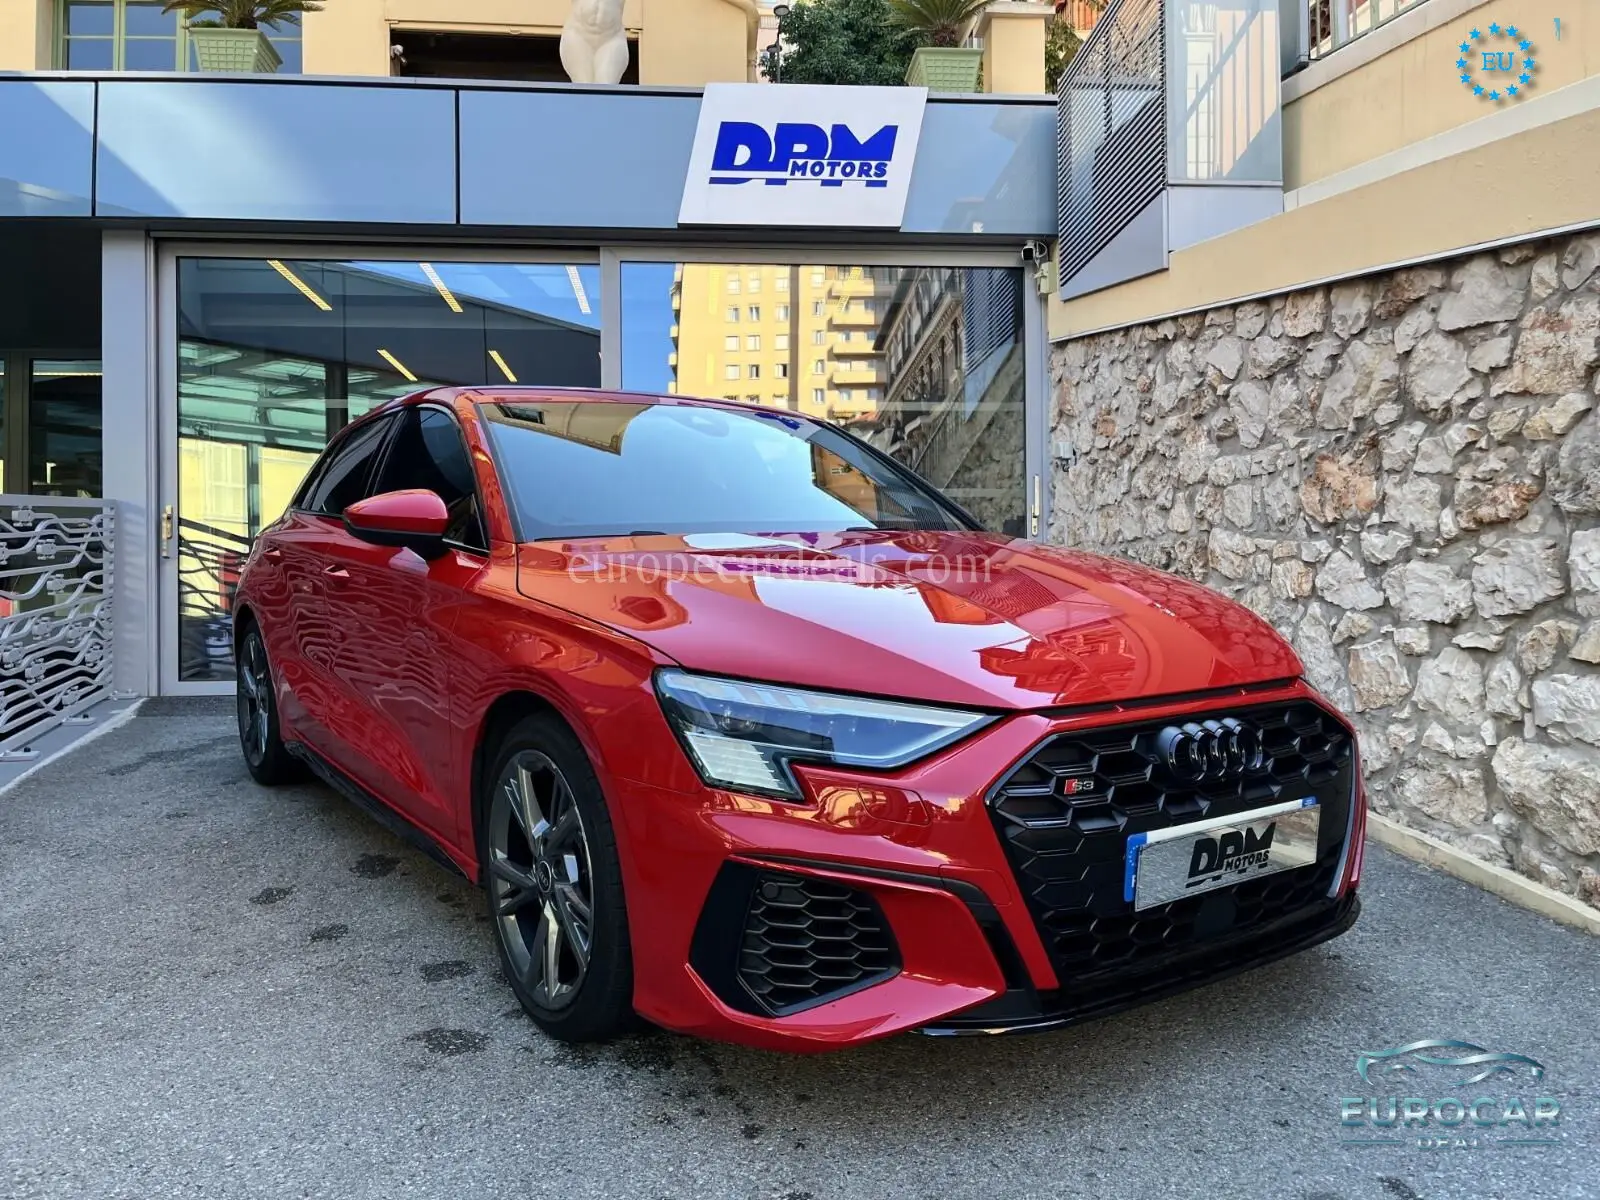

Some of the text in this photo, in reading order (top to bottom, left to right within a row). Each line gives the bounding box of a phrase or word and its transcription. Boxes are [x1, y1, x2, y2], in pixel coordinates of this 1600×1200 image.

[709, 121, 898, 187] DPM
[790, 160, 887, 178] MOTORS
[1072, 780, 1094, 791] S3
[1185, 822, 1277, 888] DPM
[1225, 850, 1270, 871] MOTORS
